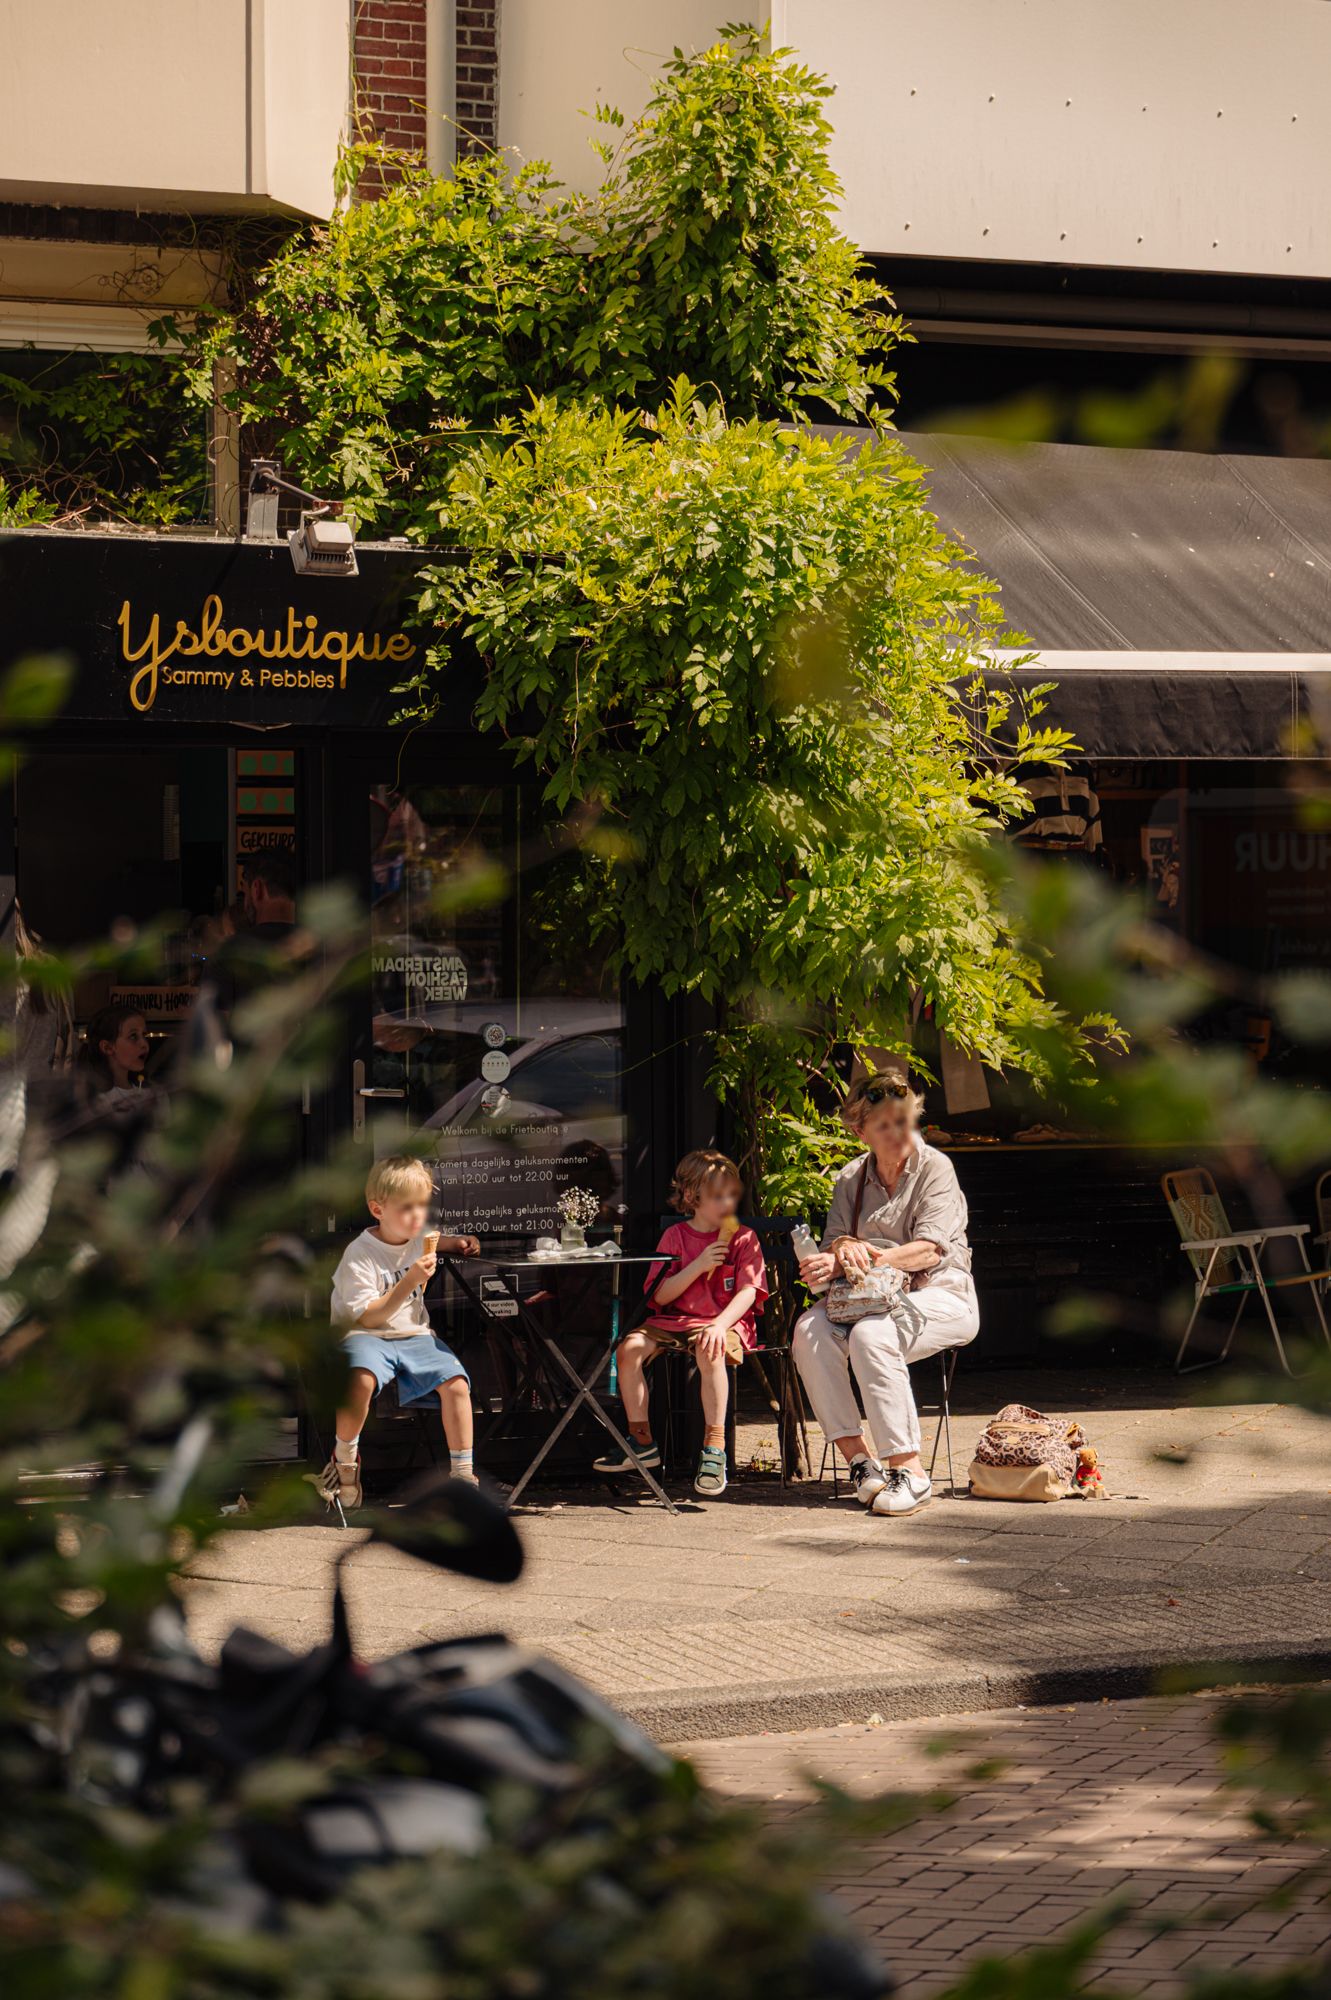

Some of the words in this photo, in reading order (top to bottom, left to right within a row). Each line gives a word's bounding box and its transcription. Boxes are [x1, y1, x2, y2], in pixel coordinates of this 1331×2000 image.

[161, 666, 234, 689] Sammy
[240, 670, 254, 686] &
[260, 669, 335, 688] Pebbles
[442, 1125, 477, 1136] Welkom
[481, 1124, 492, 1136] bij
[496, 1125, 507, 1135] de
[511, 1124, 569, 1136] Frietboutiqe
[434, 1159, 467, 1169] Zomers
[472, 1157, 510, 1170] dagelijks
[514, 1155, 588, 1168] geluksmomenten
[442, 1177, 458, 1185] van
[462, 1173, 488, 1184] 12:00
[510, 1173, 522, 1182] tot
[525, 1171, 553, 1182] 22:00
[473, 1206, 512, 1219] dagelijks
[443, 1226, 459, 1235] van
[463, 1221, 489, 1233] 12:00
[492, 1224, 506, 1232] uur
[511, 1222, 522, 1231] tot
[526, 1219, 553, 1231] 21:00
